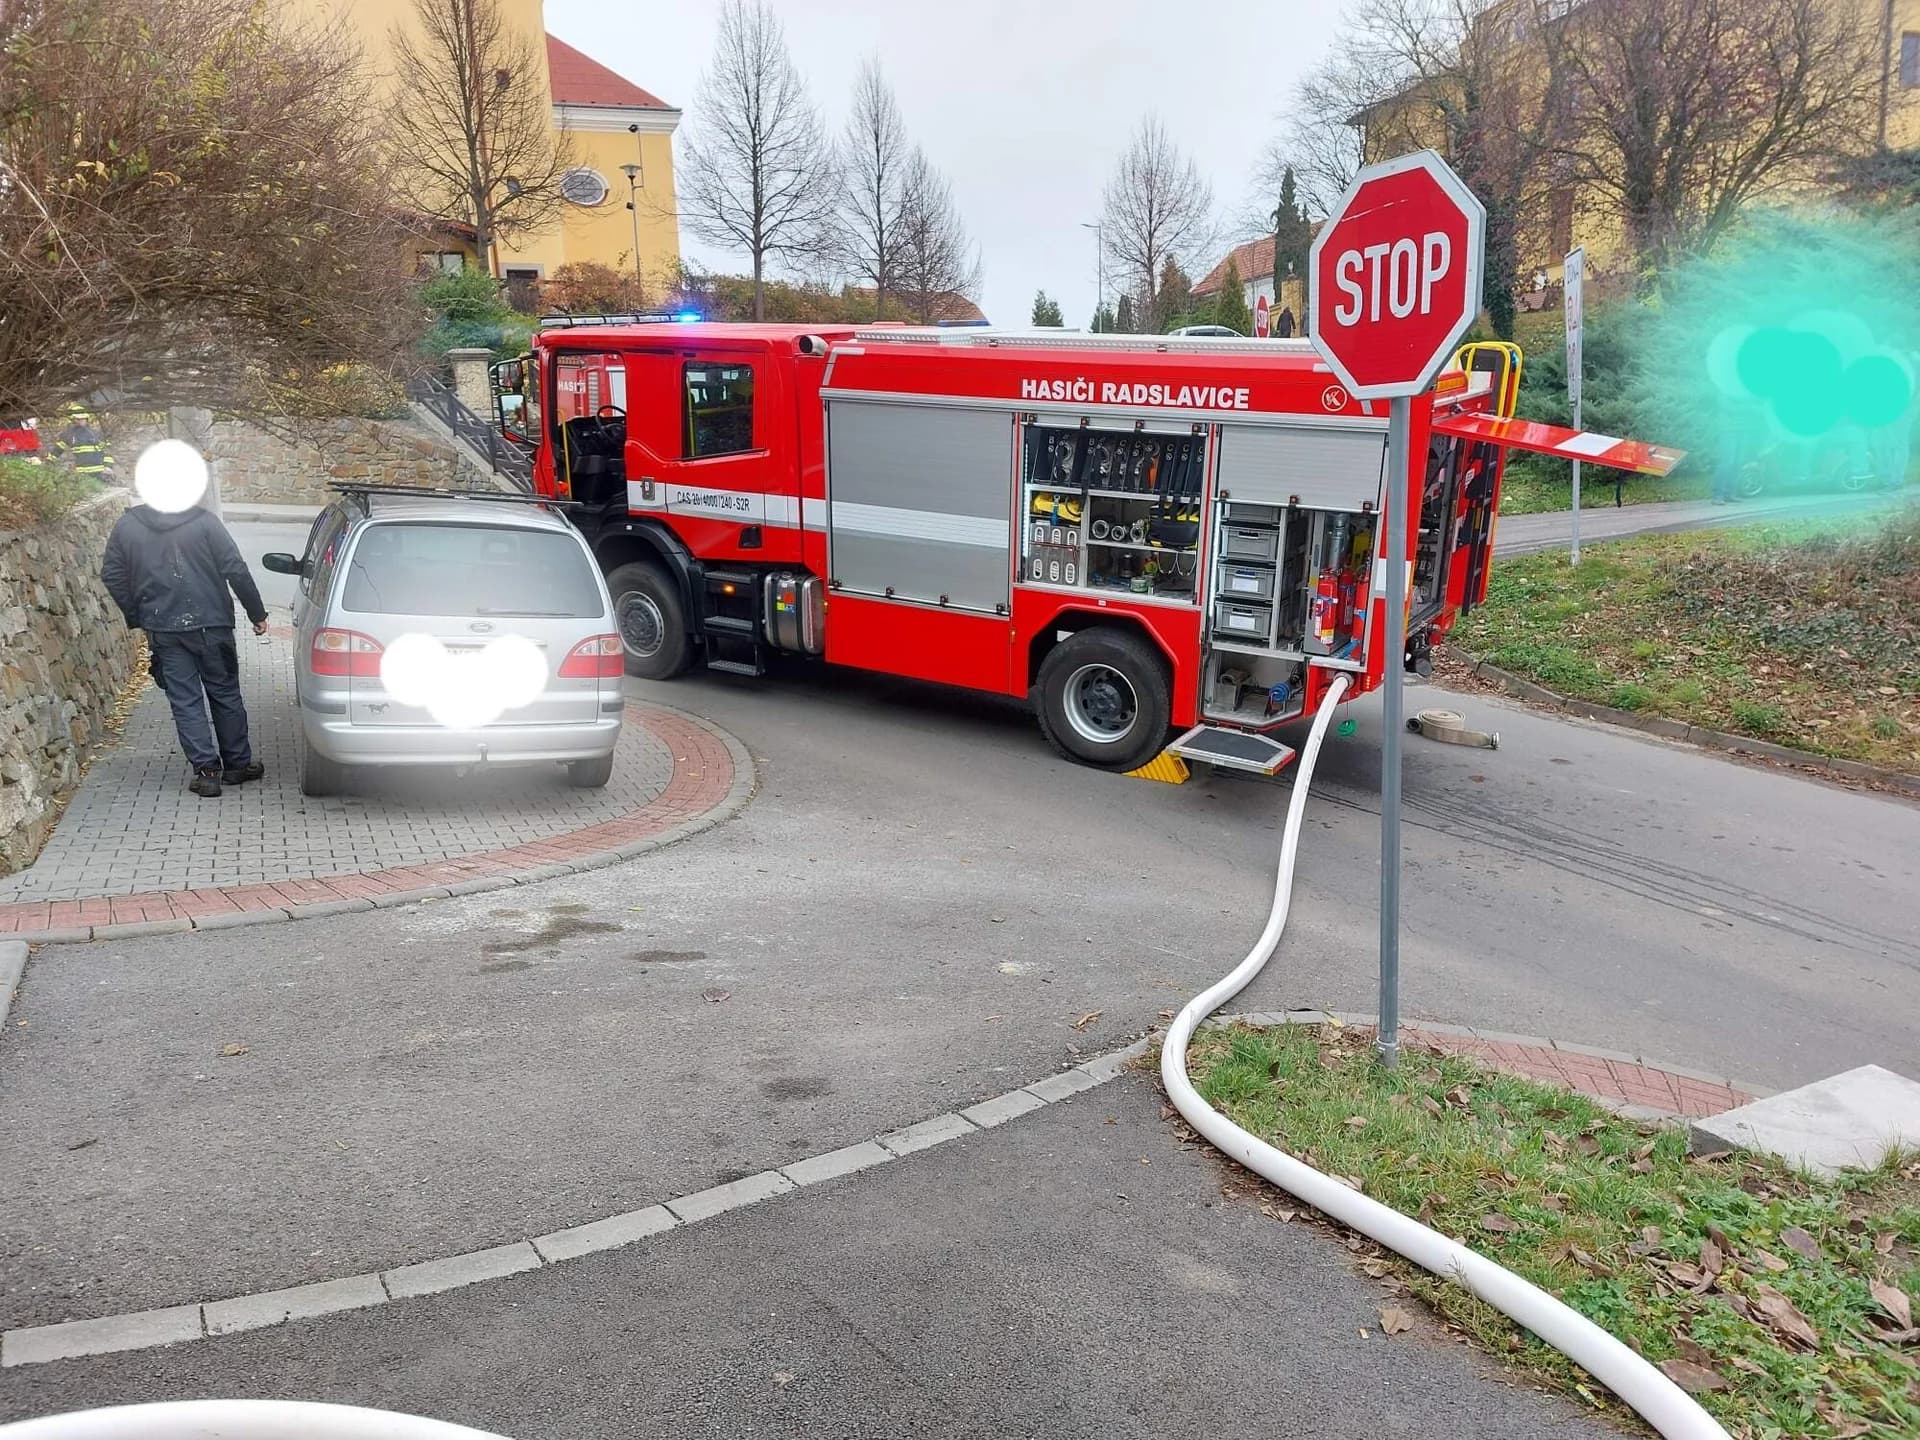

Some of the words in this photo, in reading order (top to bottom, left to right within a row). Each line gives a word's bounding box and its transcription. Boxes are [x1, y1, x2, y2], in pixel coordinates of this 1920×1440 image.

[1335, 231, 1451, 327] STOP
[1022, 377, 1095, 401] HASIČI
[1102, 382, 1250, 409] RADSLAVICE
[677, 491, 691, 504] CAS
